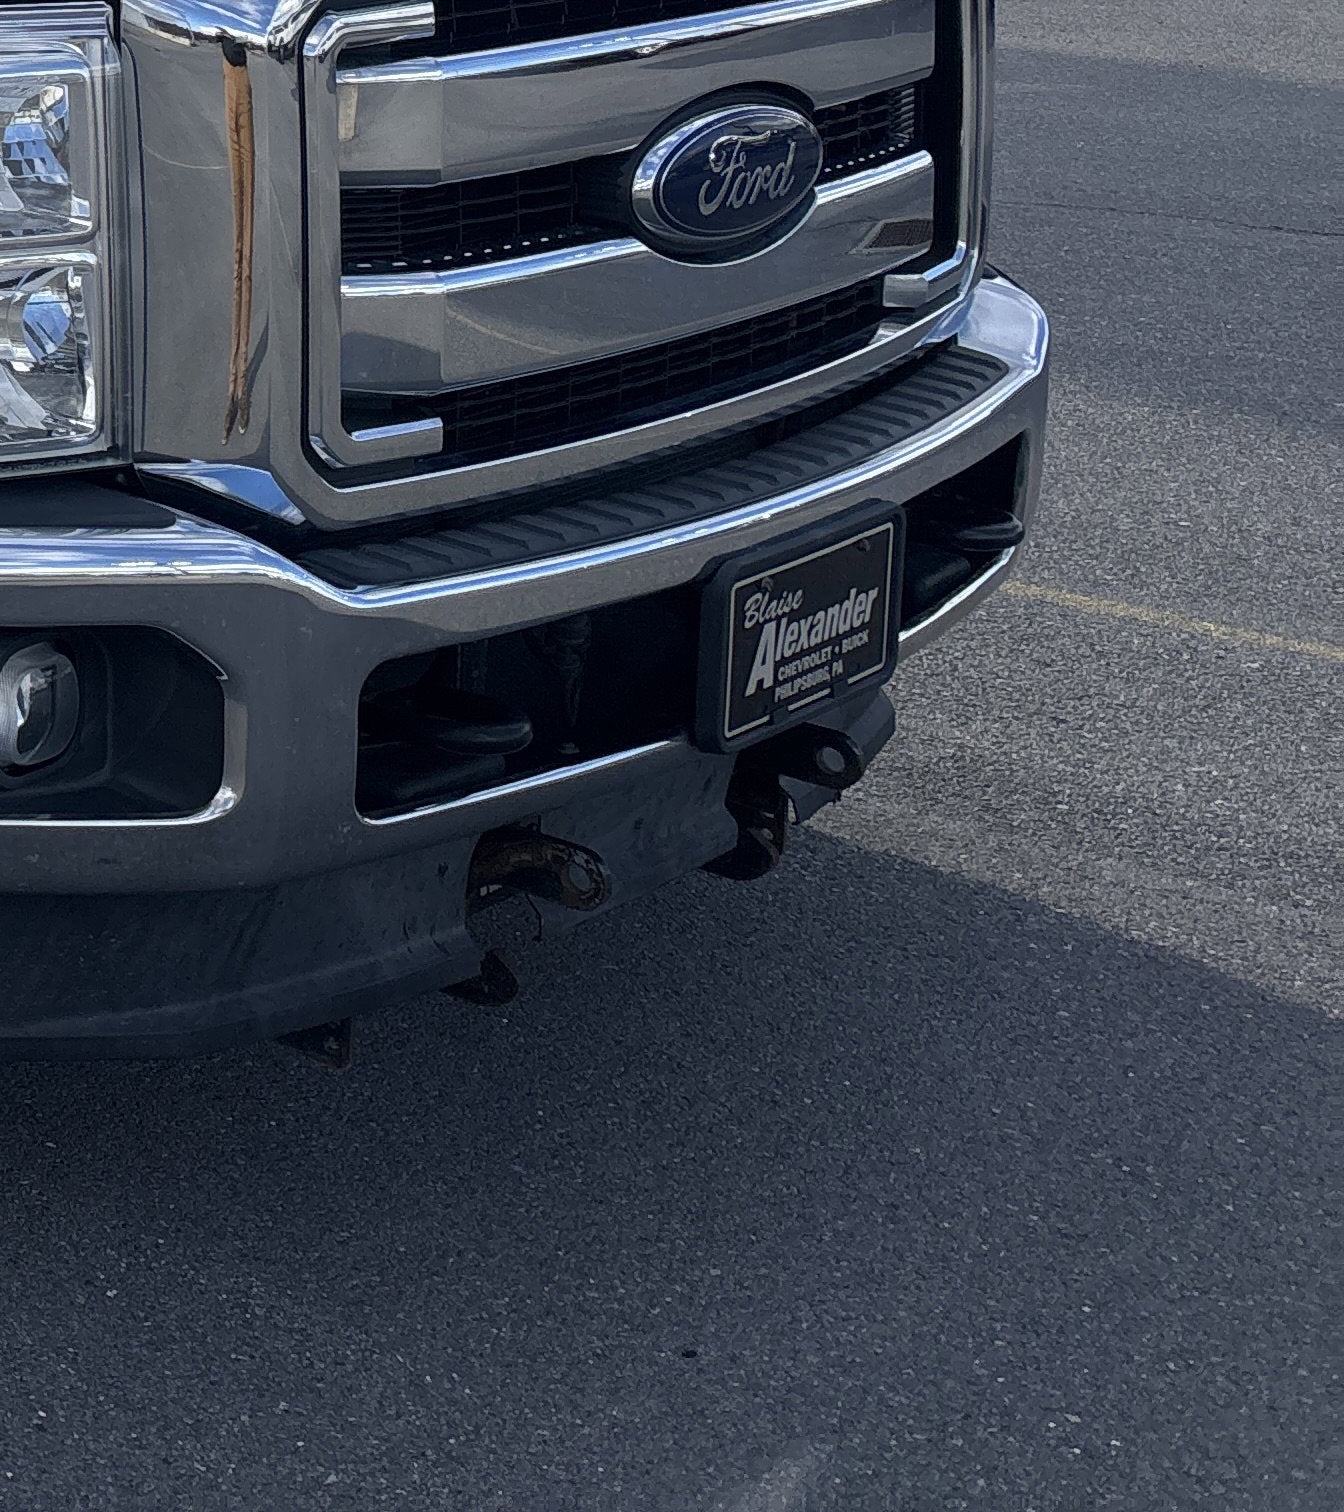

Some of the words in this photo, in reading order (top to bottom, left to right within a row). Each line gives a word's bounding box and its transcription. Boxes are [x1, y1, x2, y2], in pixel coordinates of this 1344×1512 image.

[698, 129, 797, 216] Ford
[743, 589, 804, 629] Blaise
[744, 587, 879, 698] Alexander
[778, 645, 833, 681] CHEVROLET
[832, 659, 843, 677] PA
